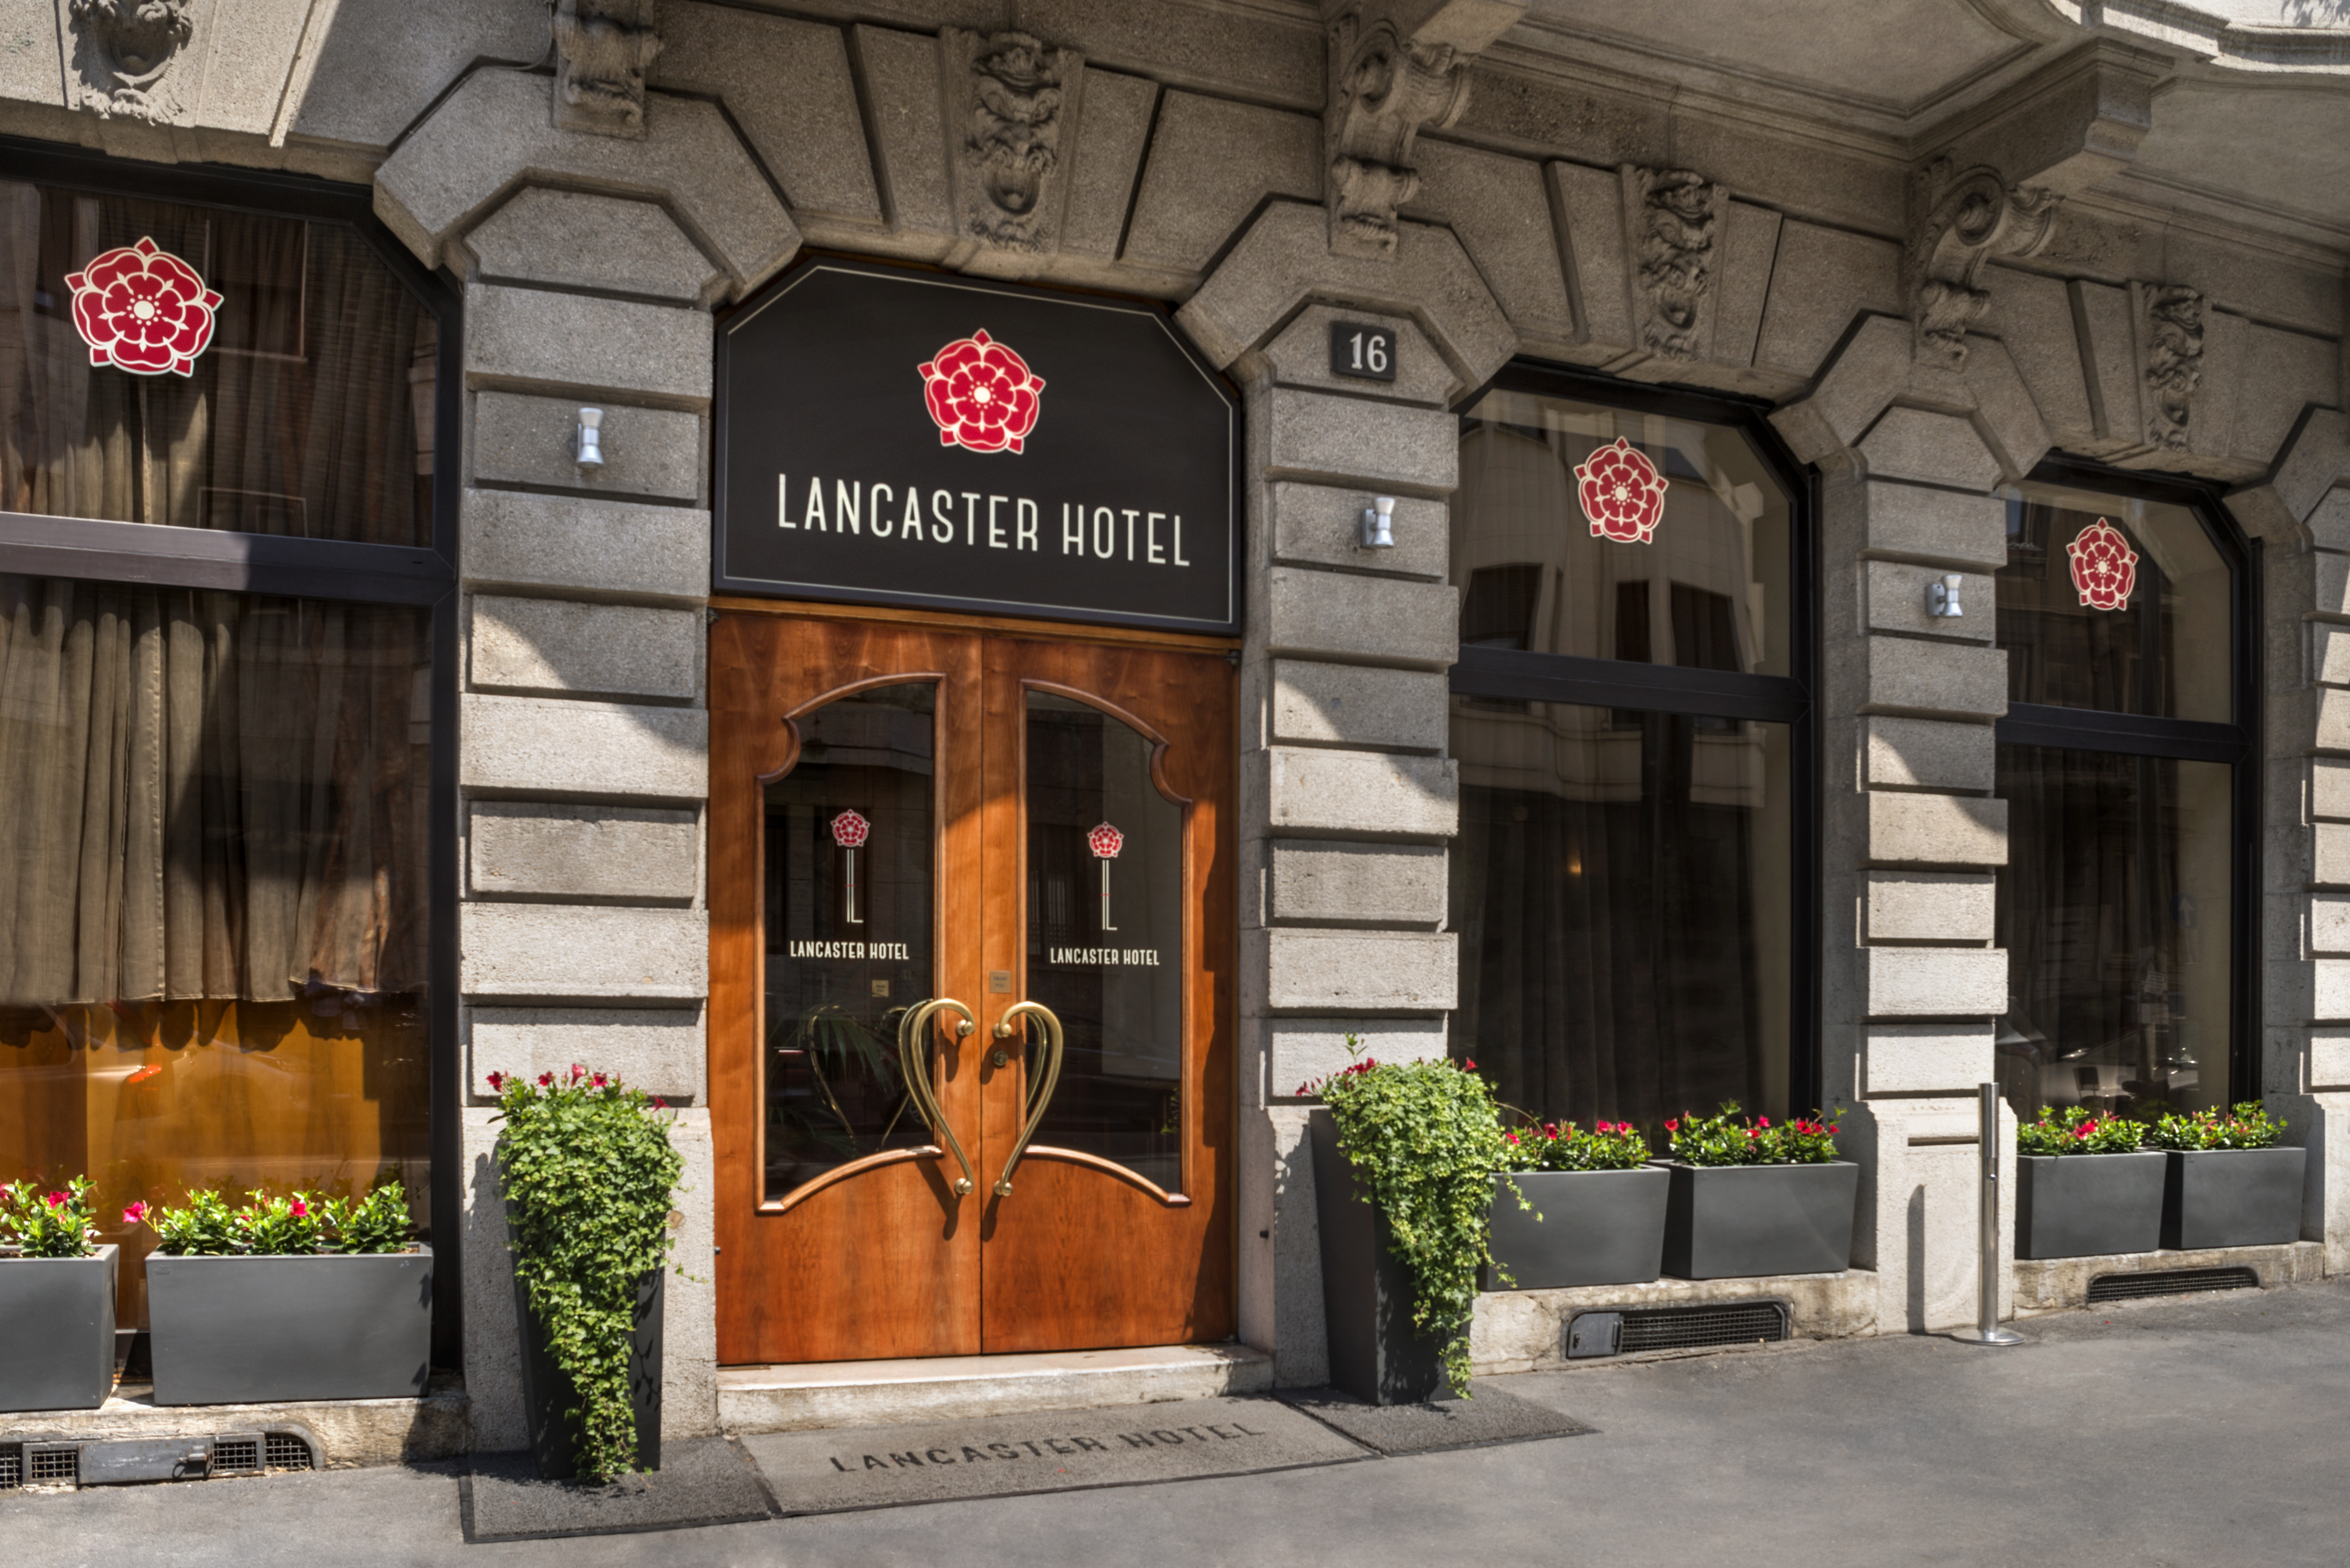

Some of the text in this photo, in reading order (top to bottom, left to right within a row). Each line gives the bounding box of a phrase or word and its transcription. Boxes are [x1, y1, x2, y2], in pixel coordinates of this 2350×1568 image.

[1350, 332, 1388, 373] 16
[778, 473, 1190, 566] LANCASTER HOTEL
[790, 940, 909, 960] LANCASTER HOTEL
[1050, 947, 1160, 966] LANCASTER HOTEL
[829, 1423, 1265, 1472] LANCASTER HOTEL
